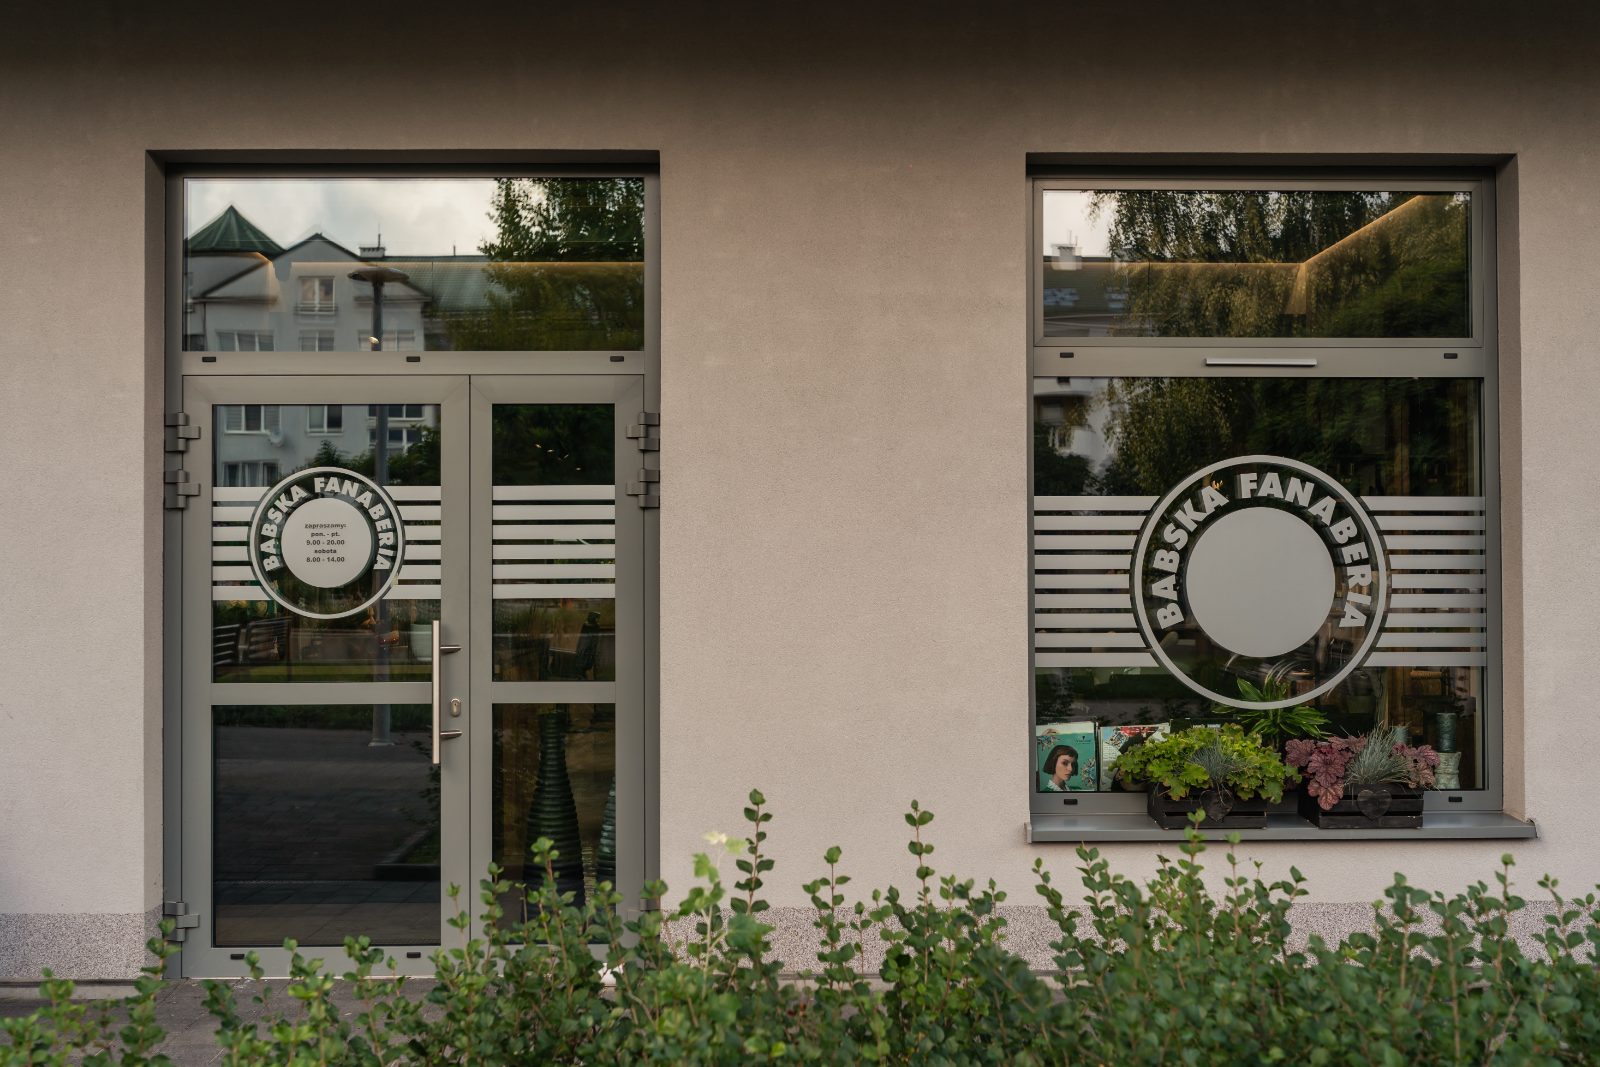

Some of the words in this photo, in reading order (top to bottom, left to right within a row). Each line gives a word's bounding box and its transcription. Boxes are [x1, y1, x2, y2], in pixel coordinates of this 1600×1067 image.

[260, 484, 309, 572] BABSKA
[313, 476, 395, 570] FANABERIA
[1151, 485, 1229, 629] BABSKA
[1239, 472, 1372, 628] FANABERIA
